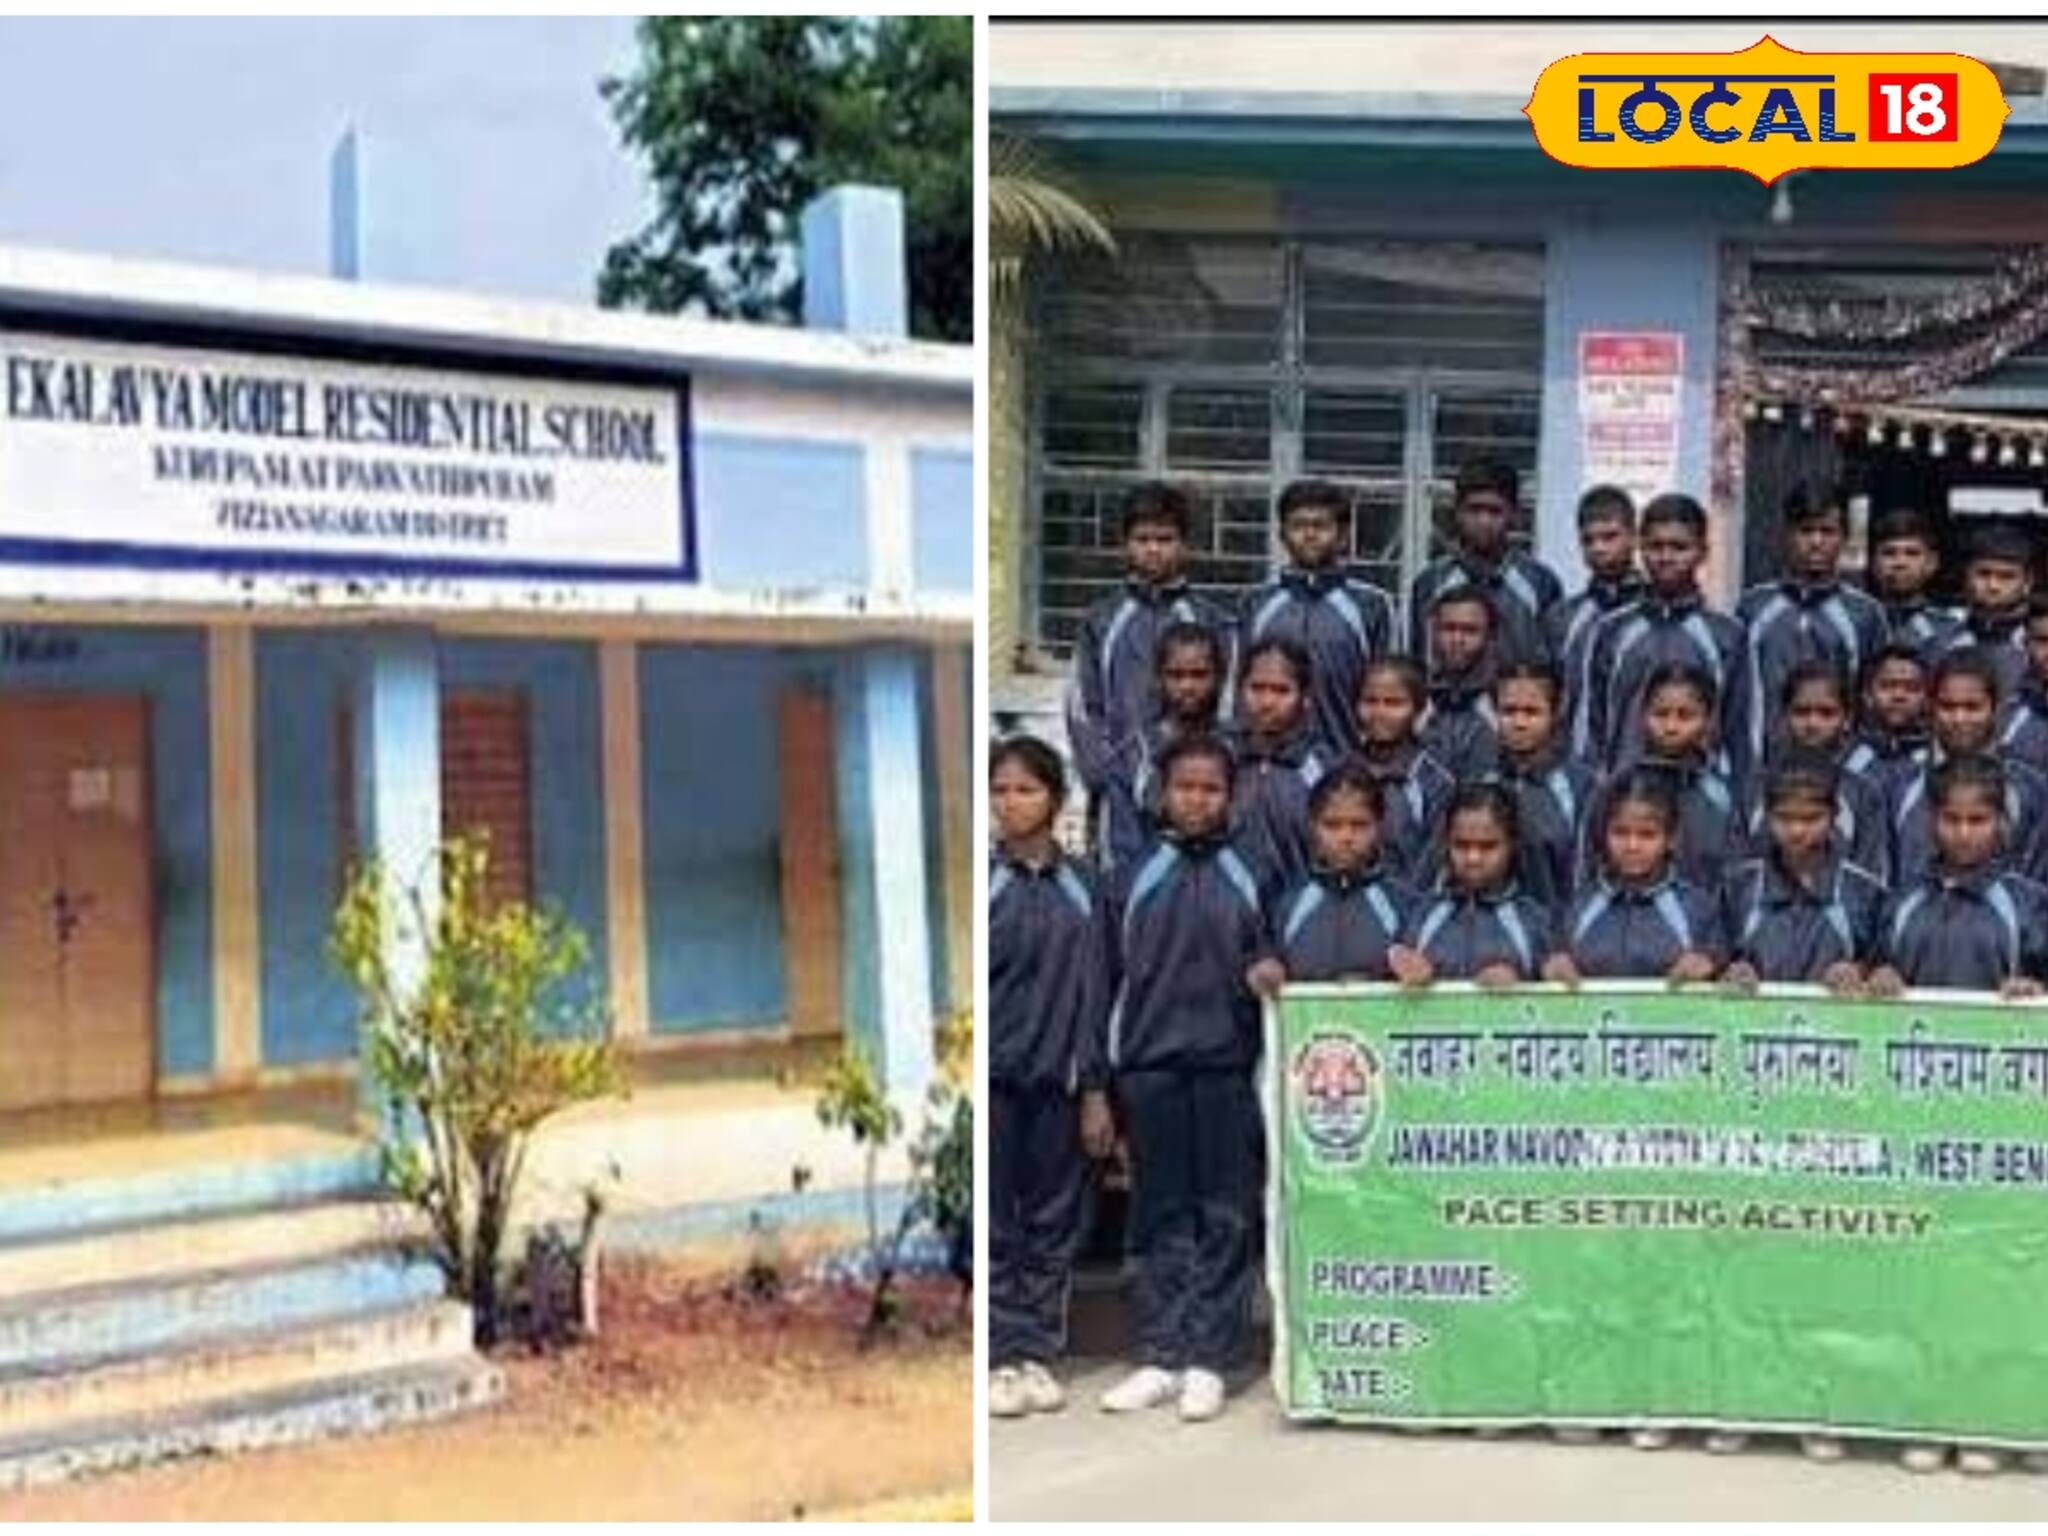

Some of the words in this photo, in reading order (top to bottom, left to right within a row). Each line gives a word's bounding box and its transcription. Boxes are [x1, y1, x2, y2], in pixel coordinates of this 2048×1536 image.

[8, 355, 194, 428] EKALAVYA
[200, 372, 320, 438] MODEL
[322, 383, 543, 456] RESIDENTIAL
[1388, 1128, 1498, 1167] JAWAHAR
[1914, 1141, 1984, 1182] WEST
[1445, 1199, 1544, 1226] PACE
[1558, 1200, 1727, 1228] SETTING
[1740, 1202, 1931, 1236] ACTIVITY
[1312, 1262, 1494, 1297] PROGRAMME
[1311, 1323, 1403, 1350] PLACE
